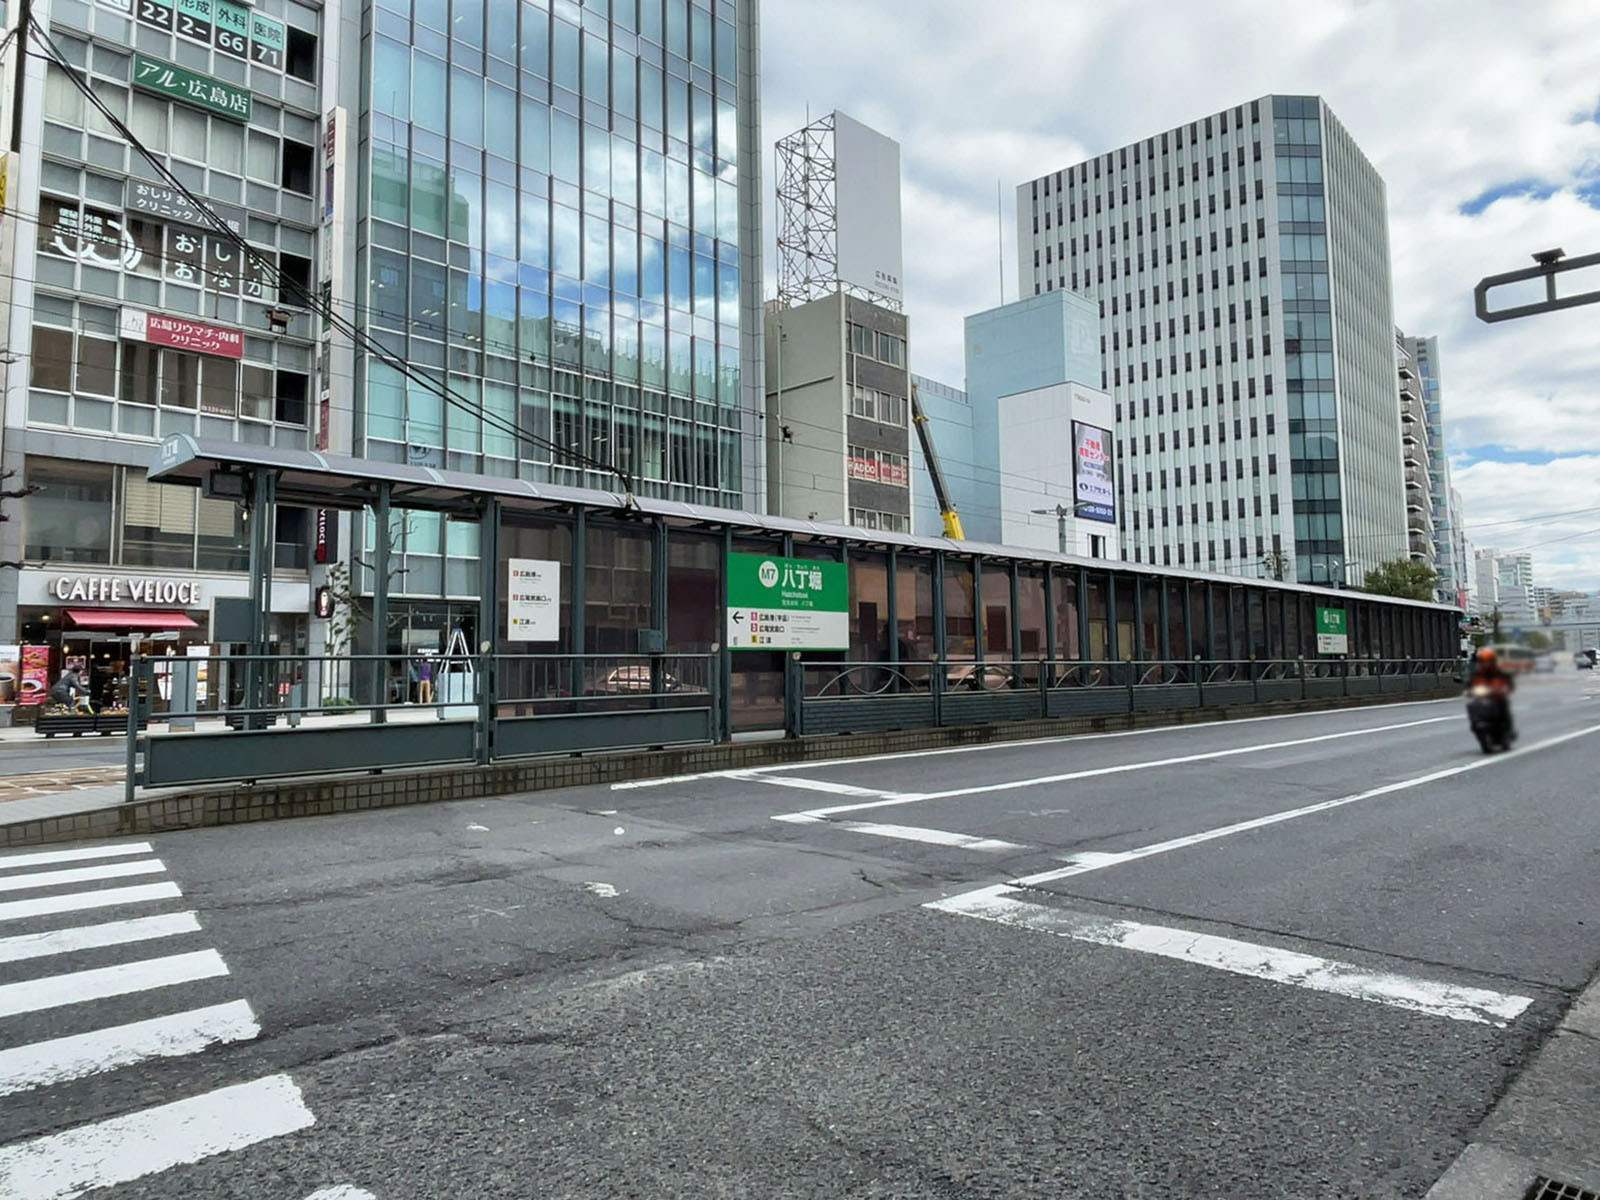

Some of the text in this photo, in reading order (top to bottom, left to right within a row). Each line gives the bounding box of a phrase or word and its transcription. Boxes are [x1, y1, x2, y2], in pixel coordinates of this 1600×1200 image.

[137, 61, 249, 114] アル・広島店
[137, 184, 172, 201] おしり
[136, 198, 193, 220] クリニック
[170, 333, 221, 351] クリニック
[760, 567, 777, 581] M7
[782, 569, 823, 591] 八丁堀
[127, 579, 200, 604] VELOCE
